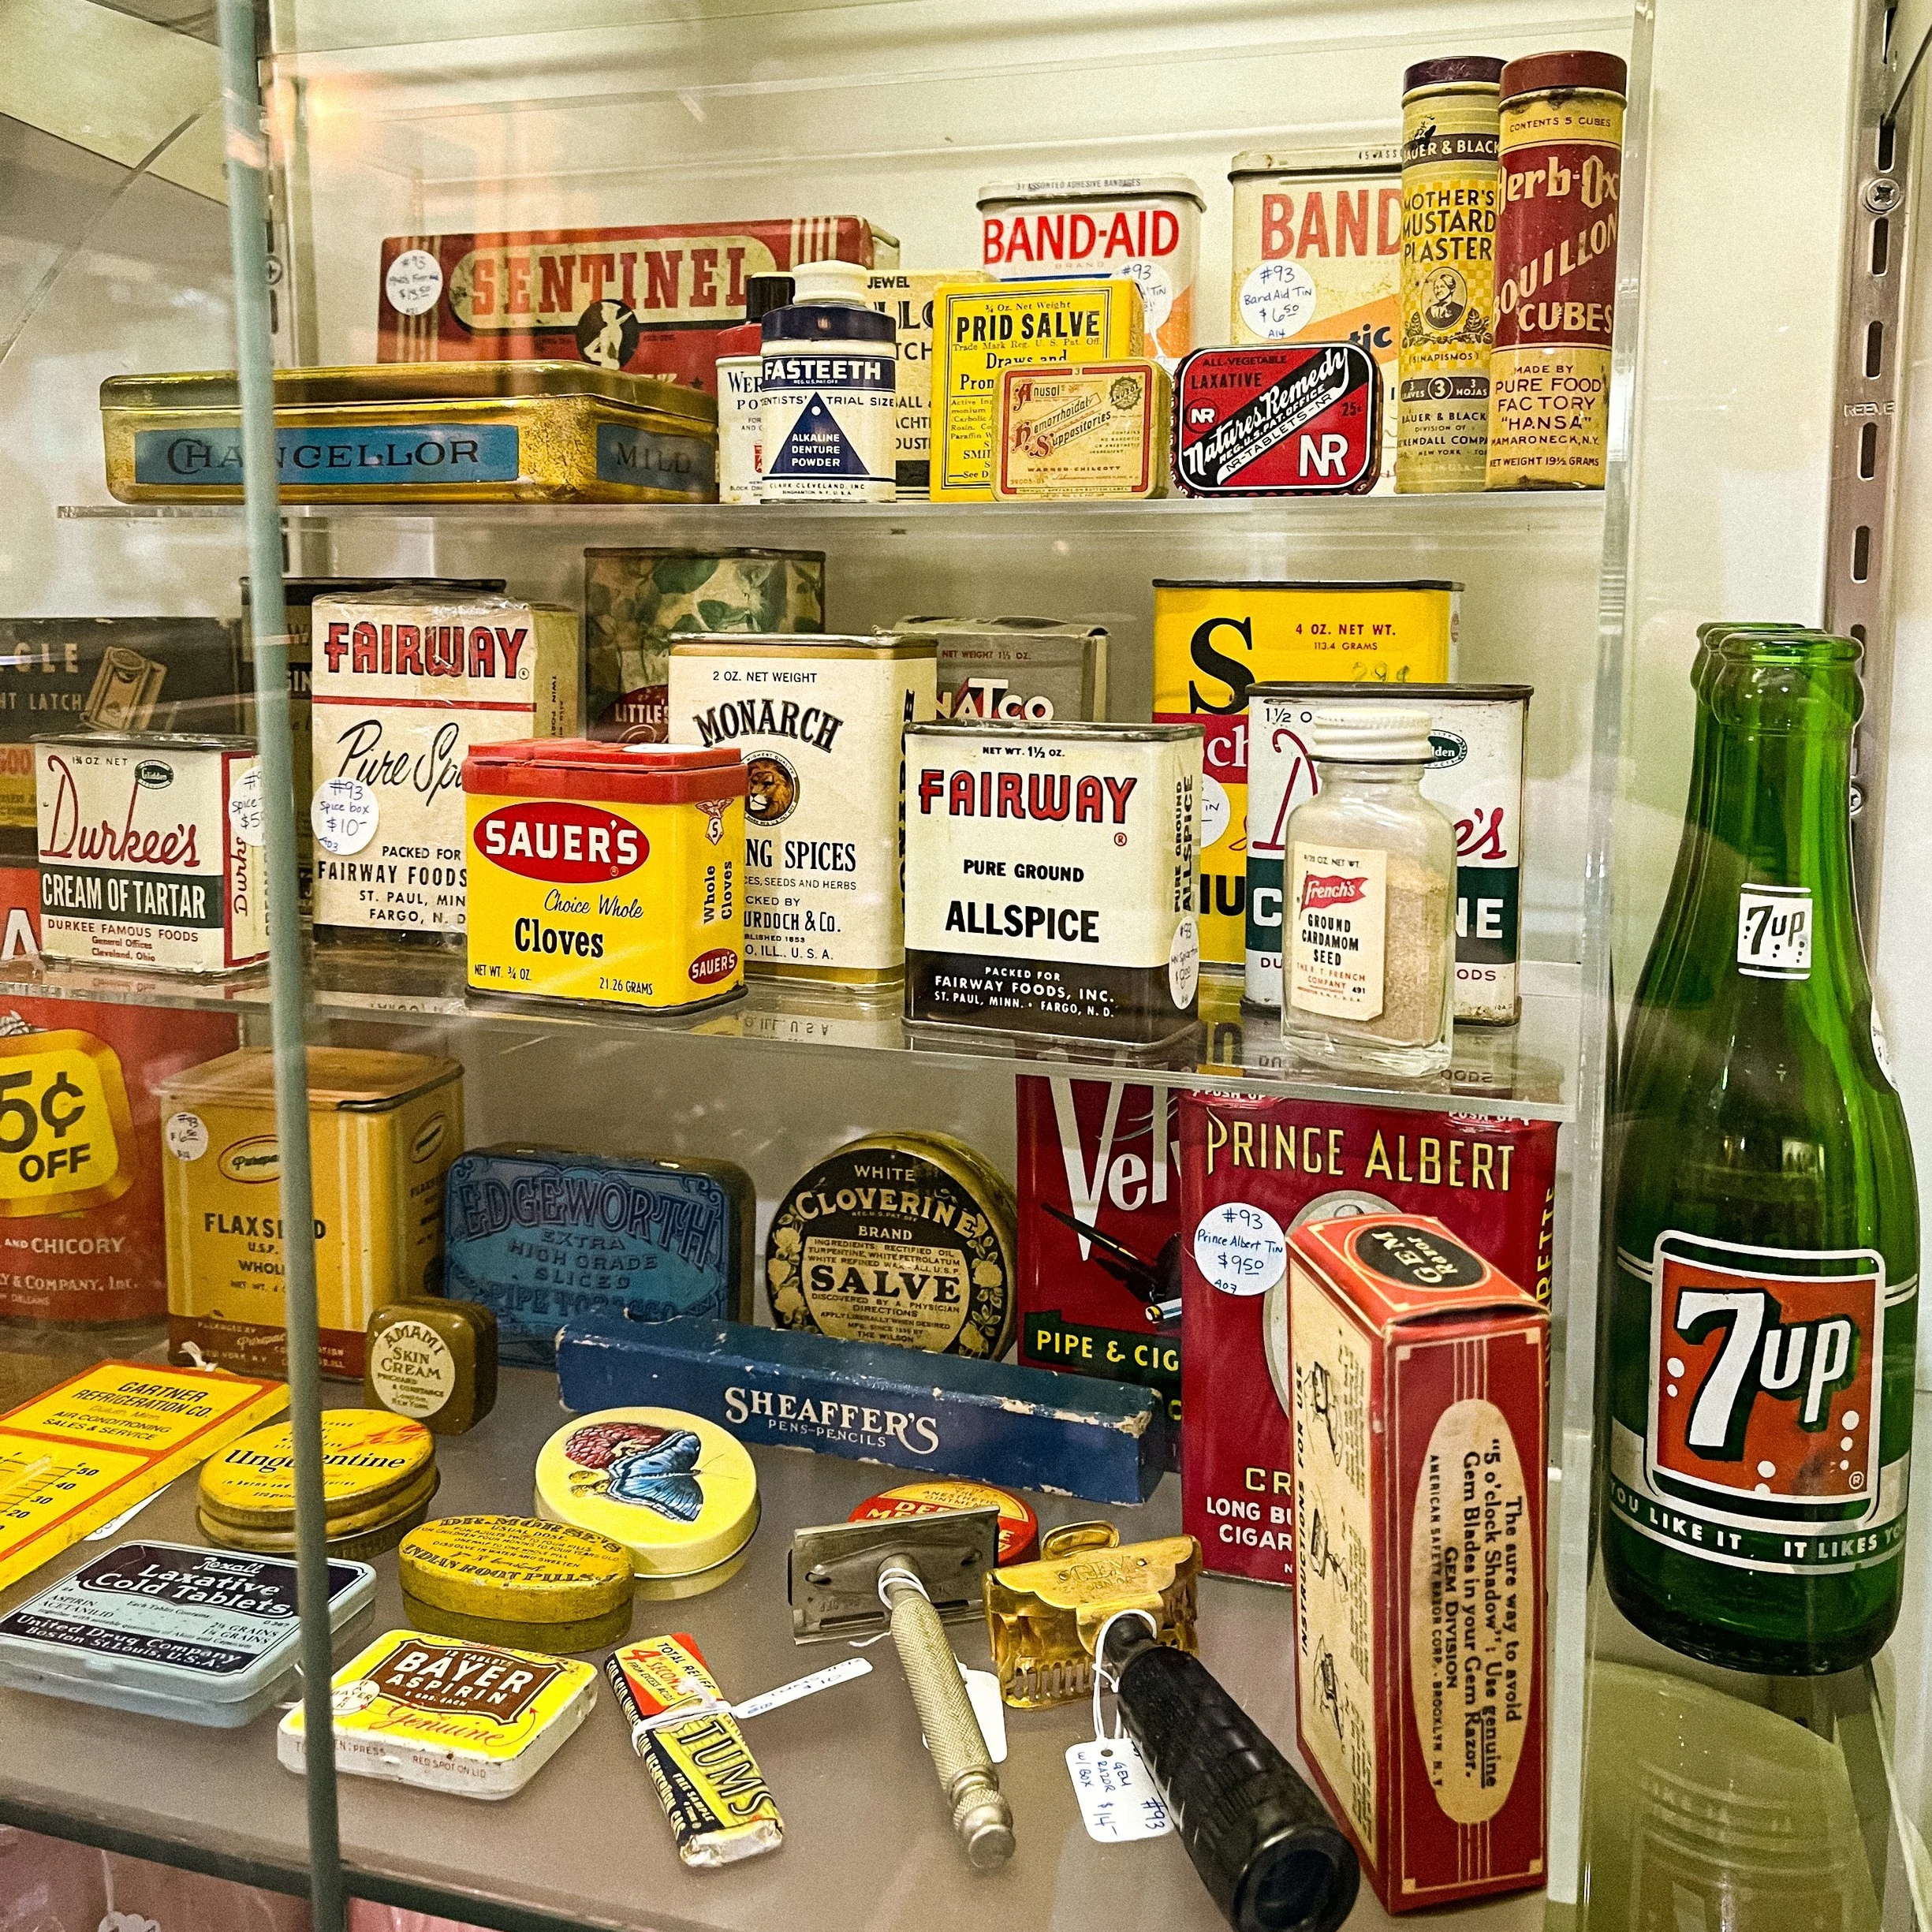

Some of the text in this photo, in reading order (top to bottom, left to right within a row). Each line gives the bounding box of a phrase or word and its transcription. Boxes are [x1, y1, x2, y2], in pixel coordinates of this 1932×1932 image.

[1509, 117, 1611, 132] CONTENTS CUBES
[1262, 188, 1403, 260] BAND
[1402, 208, 1496, 237] MUSTARD
[984, 210, 1179, 264] BAND-AID
[1404, 237, 1492, 265] PLASTER
[472, 247, 751, 314] SENTINEL
[867, 276, 910, 289] JEWEL
[1121, 264, 1151, 280] #93
[1260, 266, 1295, 284] #93
[1244, 289, 1289, 305] Band Aid
[957, 311, 1100, 342] PRID SALVE
[1518, 302, 1612, 334] CUBES
[765, 360, 880, 380] FASTEETH
[1191, 373, 1262, 389] LAXATIVE
[1515, 365, 1573, 375] MADE BY
[1259, 348, 1349, 420] Remedy
[1496, 377, 1602, 394] PURE FOOD
[826, 396, 893, 407] TRIAL SIZE
[1191, 408, 1215, 423] NR
[616, 440, 691, 474] MILD
[1299, 434, 1348, 477] NR
[1504, 457, 1599, 466] WEIGHT GRAMS
[1311, 624, 1397, 636] OZ. NET WT.
[324, 621, 529, 679] FAIRWAY
[961, 650, 994, 659] WEIGHT
[1341, 641, 1378, 651] GRAMS
[747, 672, 817, 684] NET WEIGHT
[692, 698, 844, 754] MONARCH
[329, 780, 364, 800] #93
[919, 769, 1137, 825] FAIRWAY
[39, 755, 201, 867] Durkee's
[382, 846, 461, 860] PACKED FOR
[486, 819, 638, 865] SAUER'S
[785, 841, 856, 872] SPICES
[318, 861, 467, 887] FAIRWAY FOODS
[964, 859, 1085, 883] PURE GROUND
[703, 865, 716, 924] Whole
[721, 860, 733, 920] Cloves
[765, 877, 856, 890] SEEDS AND HERBS
[1305, 880, 1356, 905] French's
[42, 873, 206, 919] CREAM OF TARTAR
[360, 890, 427, 906] ST. PAUL,
[544, 889, 644, 919] Choice Whole
[785, 897, 800, 907] BY
[369, 909, 424, 924] FARGO,
[945, 900, 1100, 943] ALLSPICE
[1307, 914, 1351, 933] GROUND
[47, 919, 199, 942] DURKEE FAMOUS FOODS
[514, 918, 604, 958] Cloves
[1302, 930, 1359, 951] CARDAMOM
[1314, 949, 1341, 966] SEED
[475, 964, 487, 976] NET
[985, 966, 1061, 981] PACKED FOR
[599, 977, 653, 995] 21.26 GRAMS
[934, 975, 1115, 1003] FAIRWAY FOODS, INC.
[953, 993, 1082, 1016] PAUL, FARGO,
[1207, 1106, 1515, 1192] PRINCE ALBERT
[19, 1143, 91, 1183] OFF
[854, 1165, 916, 1182] WHITE
[460, 1175, 722, 1273] EDGEWORTH
[796, 1188, 975, 1237] CLOVERINE
[1221, 1208, 1263, 1230] #93
[541, 1230, 625, 1251] EXTRA
[858, 1225, 912, 1240] BRAND
[31, 1236, 126, 1255] CHICORY
[508, 1240, 566, 1266] HIGH
[884, 1244, 932, 1255] RECTIFIED
[535, 1268, 630, 1289] SLICED
[811, 1264, 960, 1304] SALVE
[852, 1305, 918, 1318] DIRECTIONS
[393, 1347, 430, 1364] SKIN
[1037, 1330, 1093, 1359] PIPE
[381, 1358, 441, 1379] CREAM
[72, 1389, 189, 1413] REFRIGERATION
[117, 1382, 209, 1403] GARTNER
[42, 1419, 158, 1440] SALES SERVICE
[78, 1414, 172, 1433] CONDITIONING
[724, 1386, 939, 1455] SHEAFFER'S
[768, 1419, 886, 1448] PENS-PENCILS
[54, 1482, 77, 1490] 40
[32, 1496, 54, 1505] 30
[1207, 1496, 1261, 1521] LONG
[1484, 1471, 1502, 1543] o'clock
[7, 1510, 31, 1519] 20
[1649, 1512, 1742, 1550] LIKE IT
[1784, 1533, 1878, 1558] IT LIKES
[192, 1556, 264, 1575] Rexall
[137, 1564, 282, 1597] Laxative
[1502, 1495, 1523, 1662] The sure way to
[95, 1572, 293, 1616] Cold Tablets
[1464, 1451, 1482, 1777] Gem Blades Gem Razor.
[91, 1626, 242, 1665] Drug Company
[1445, 1601, 1458, 1688] DIVISION
[393, 1651, 535, 1695] BAYER
[385, 1674, 509, 1705] ASPIRIN
[368, 1703, 505, 1747] Genuine
[1482, 1662, 1502, 1787] Use genuine
[677, 1720, 774, 1817] TUMS
